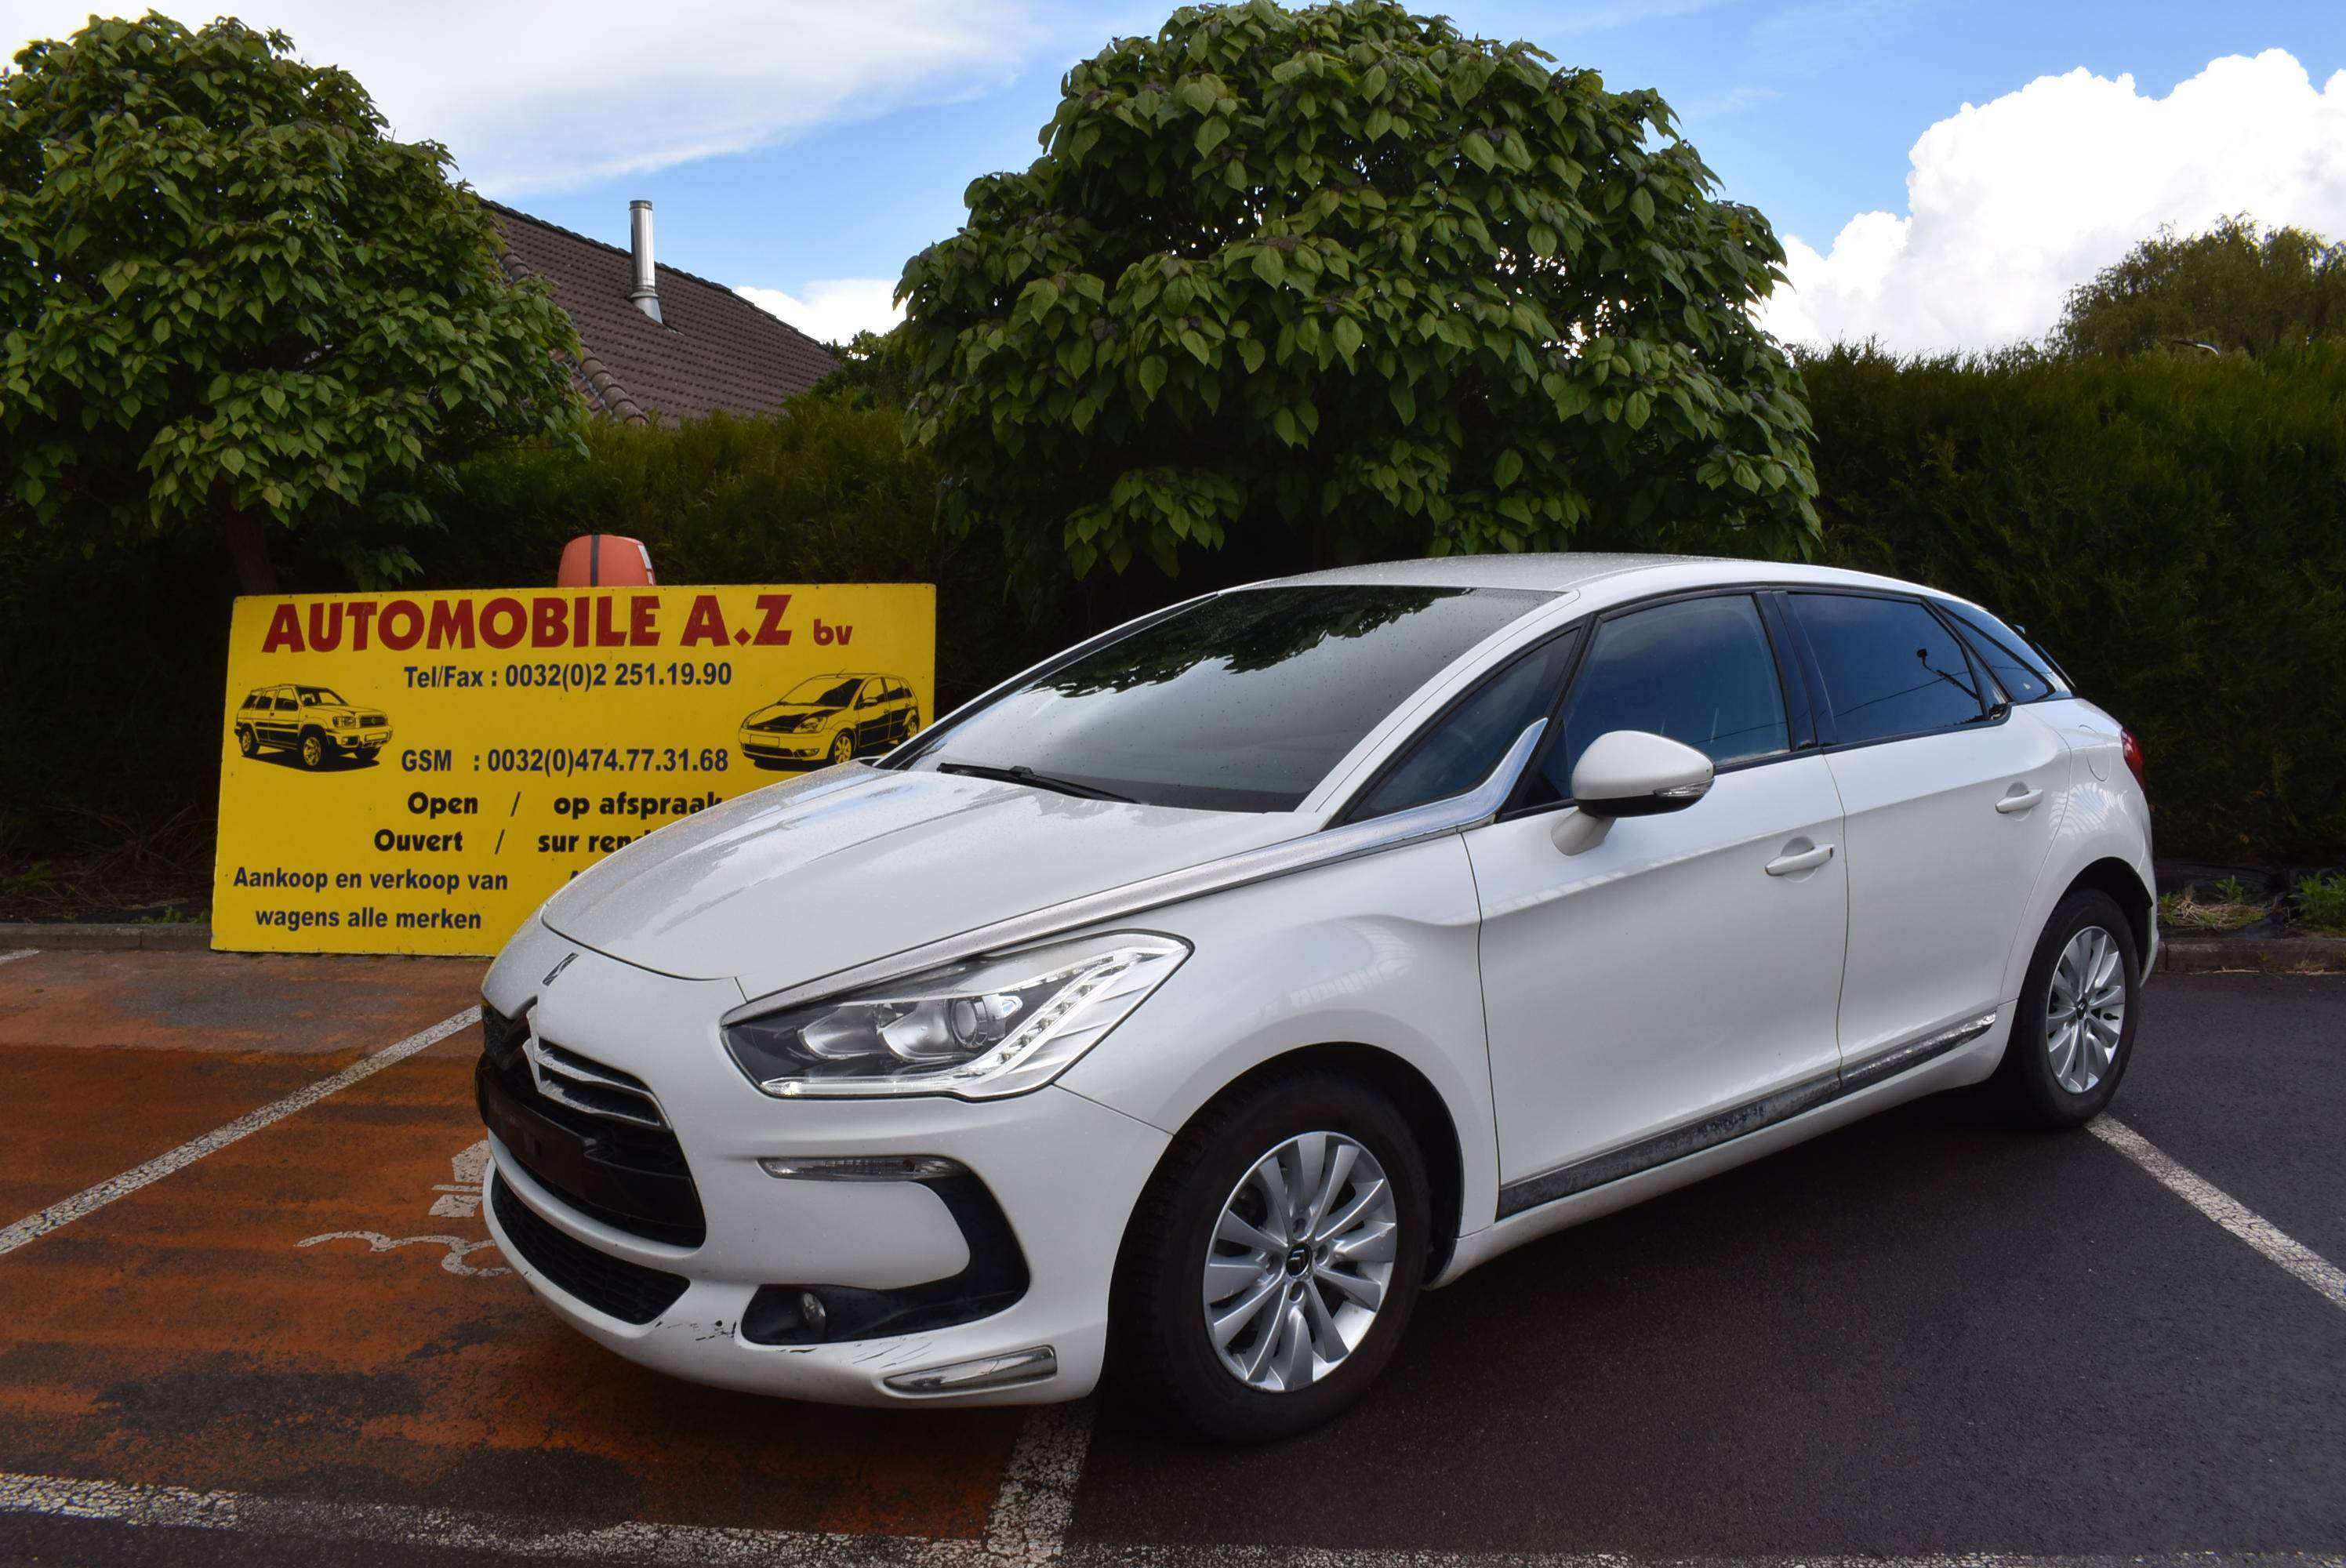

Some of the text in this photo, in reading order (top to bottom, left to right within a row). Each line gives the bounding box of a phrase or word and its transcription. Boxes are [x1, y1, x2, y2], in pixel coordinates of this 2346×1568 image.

[261, 594, 853, 653] AUTOMOBILE A.Z bv
[404, 666, 483, 688] Tel/Fax
[505, 663, 607, 691] 0032(0)2
[615, 662, 732, 686] 251.19.90
[401, 749, 452, 772] GSM
[488, 748, 728, 778] 0032(0)474.77.31.68
[407, 791, 478, 819] Open
[554, 797, 590, 820] op
[374, 829, 463, 852] Ouvert
[538, 835, 579, 853] sur
[233, 866, 508, 895] Aankoop en verkoop van
[256, 906, 481, 932] wagens alle merken
